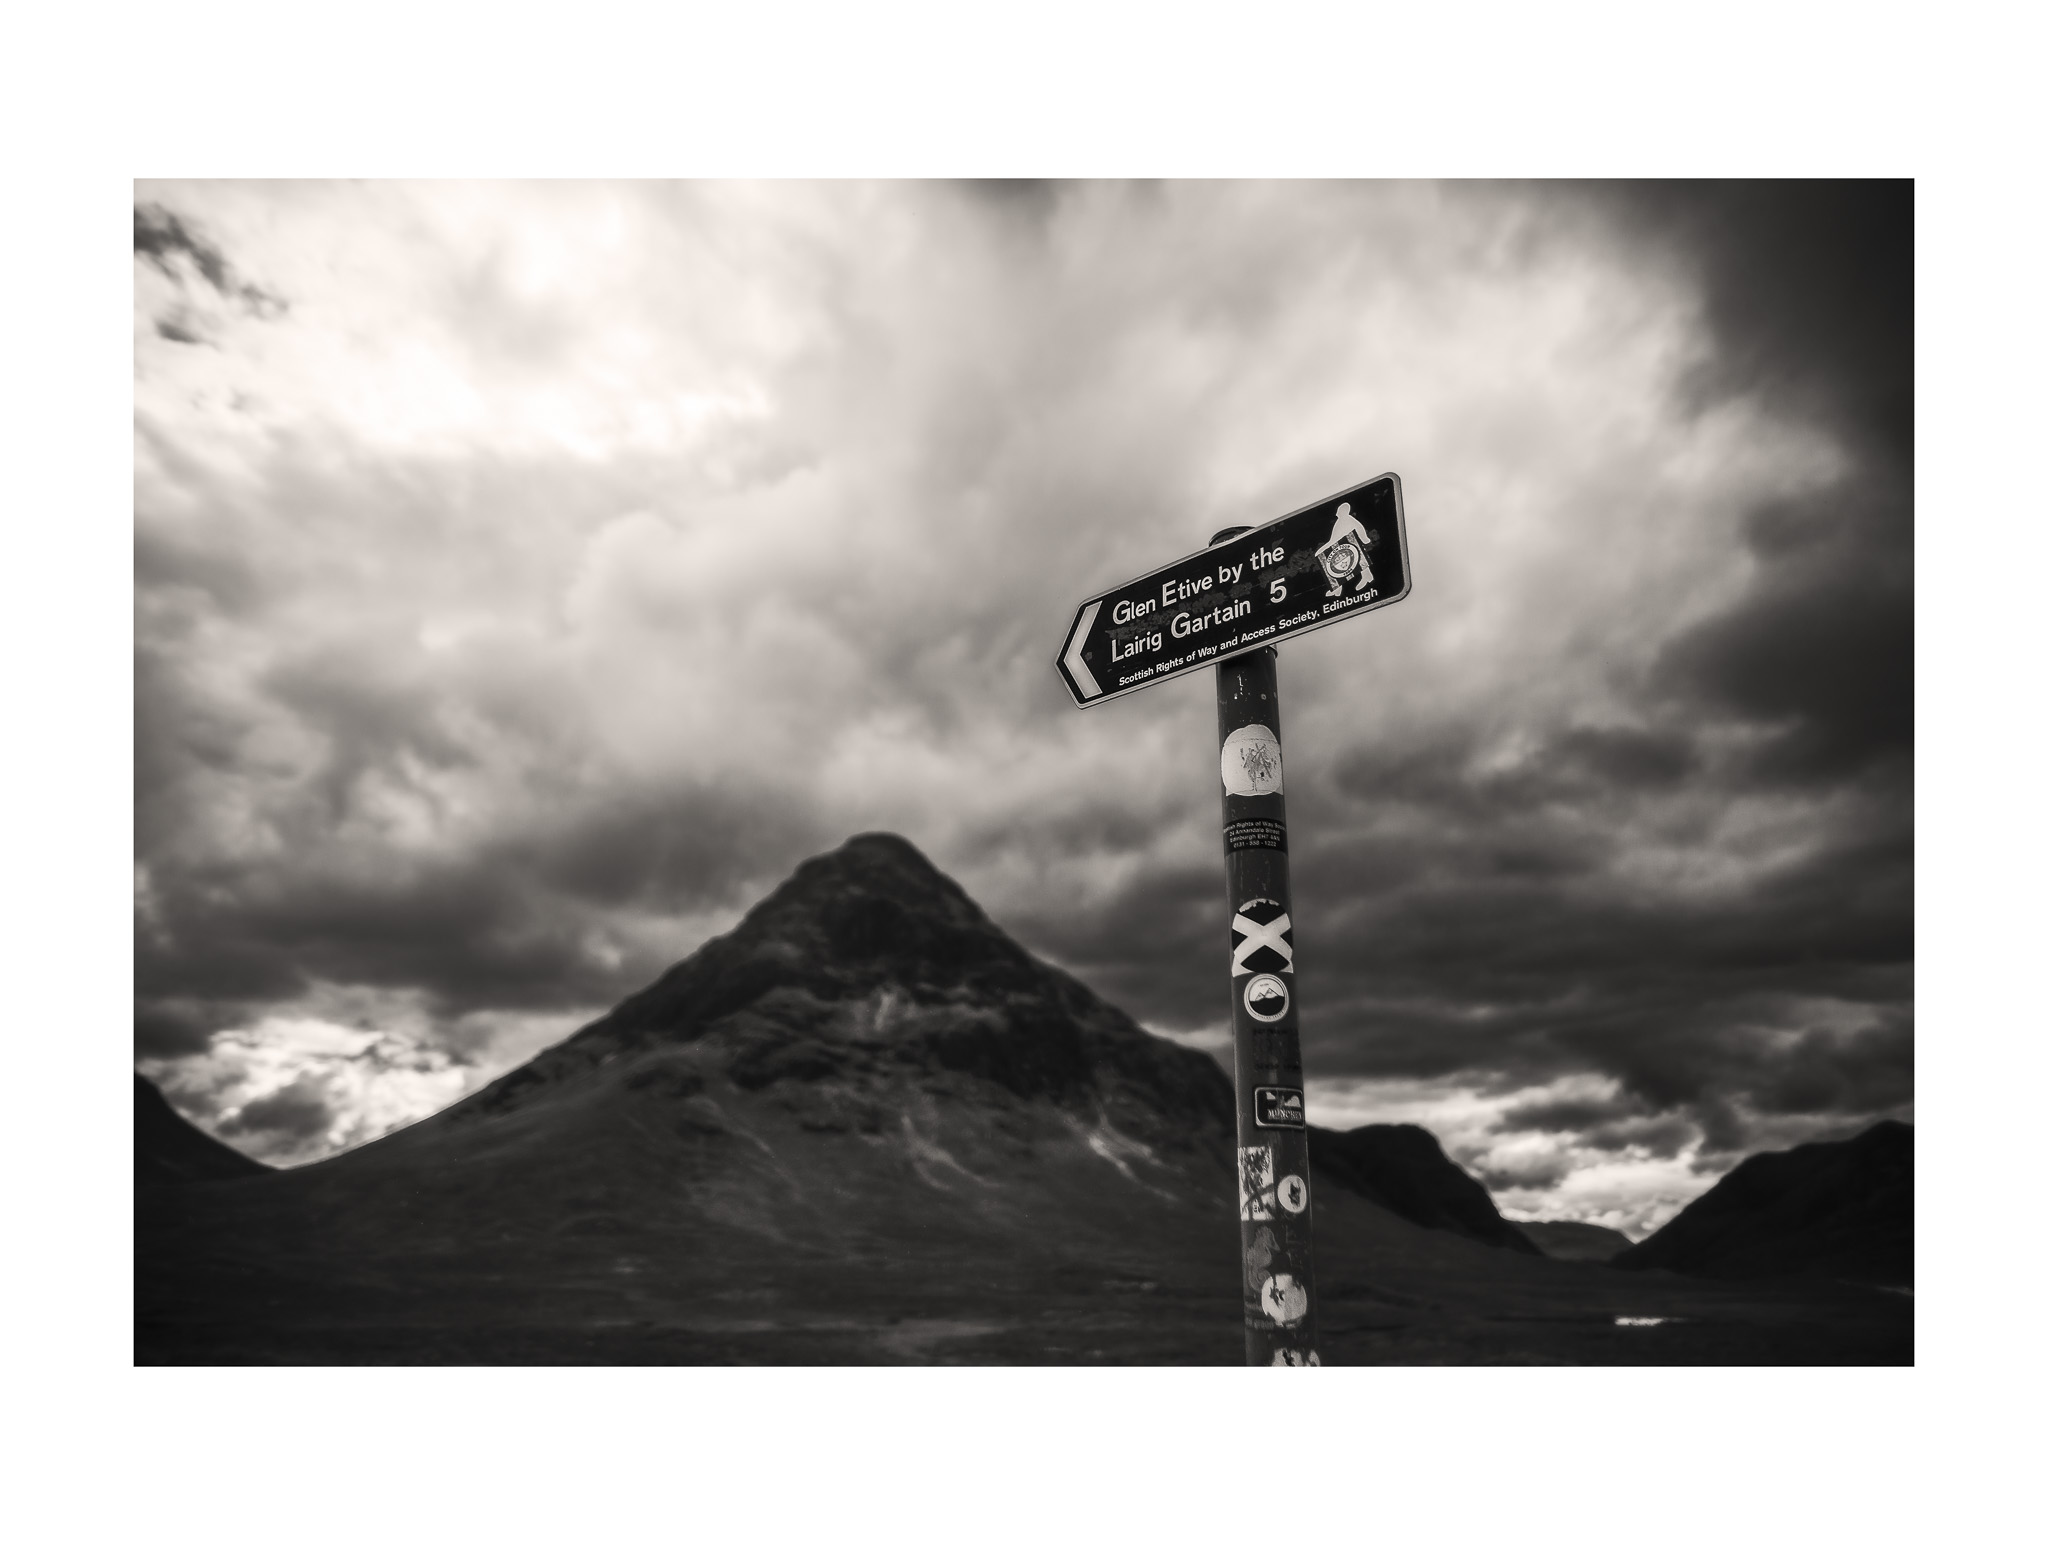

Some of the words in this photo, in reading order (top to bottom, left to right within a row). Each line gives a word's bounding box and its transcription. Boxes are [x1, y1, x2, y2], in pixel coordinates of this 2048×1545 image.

[1111, 631, 1162, 663] Lairig
[1170, 599, 1251, 639] Gartain
[1269, 577, 1287, 604] 5
[1112, 598, 1156, 625] Glen
[1162, 575, 1213, 607] Etive
[1218, 563, 1243, 583] by
[1249, 546, 1285, 571] the
[1118, 667, 1154, 686] Scottish
[1155, 657, 1184, 674] Rights
[1186, 651, 1197, 662] of
[1197, 644, 1218, 658] Way
[1219, 635, 1238, 650] and
[1240, 624, 1276, 643] Access
[1278, 609, 1320, 629] Society,
[1322, 588, 1378, 614] Edinburgh
[1229, 834, 1256, 843] Edinburgh
